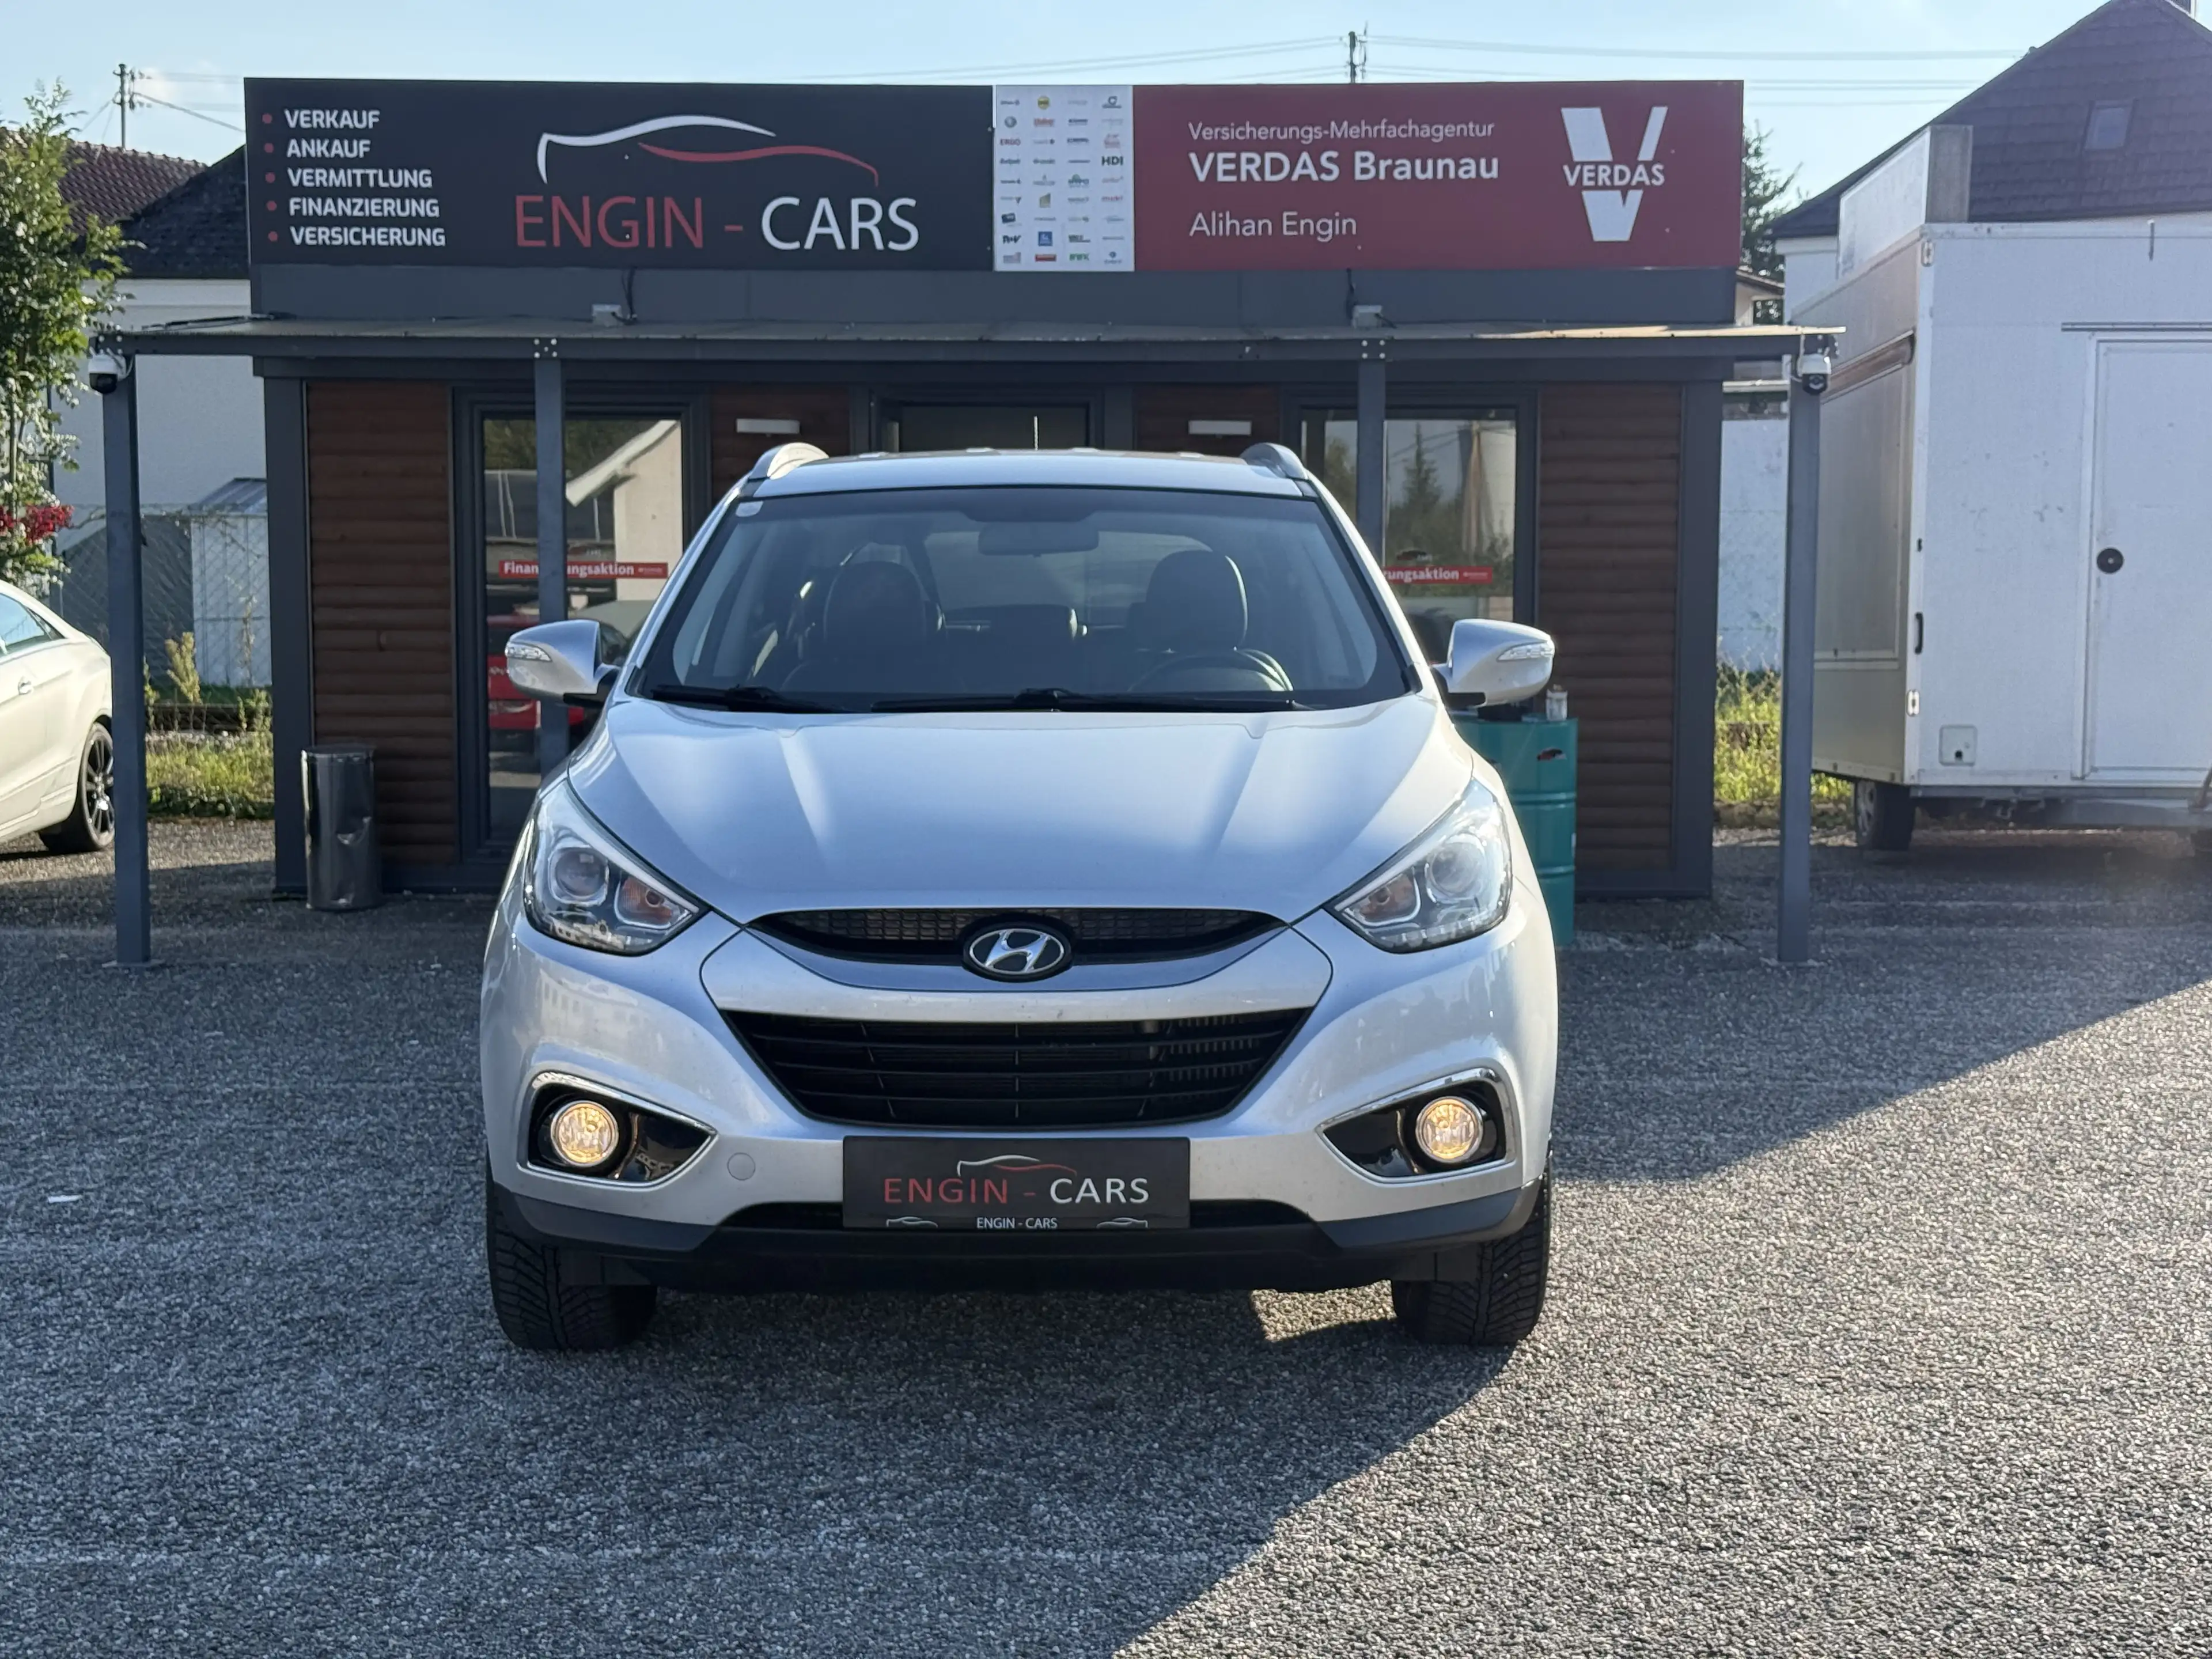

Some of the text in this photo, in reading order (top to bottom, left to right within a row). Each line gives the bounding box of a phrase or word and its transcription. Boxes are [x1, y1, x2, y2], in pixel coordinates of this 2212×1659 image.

[285, 109, 380, 128] VERKAUF
[1188, 118, 1495, 144] Versicherungs-Mehrfachagentur
[287, 139, 370, 158] ANKAUF
[1101, 156, 1124, 166] HDI
[1189, 150, 1498, 182] VERDAS Braunau
[287, 168, 432, 188] VERMITTLUNG
[1563, 164, 1665, 186] VERDAS
[290, 198, 440, 217] FINANZIERUNG
[516, 195, 703, 248] ENGIN
[762, 197, 919, 251] CARS
[1189, 211, 1357, 242] Alihan Engin
[290, 226, 446, 246] VERSICHERUNG
[885, 1179, 1007, 1204] ENGIN
[1050, 1178, 1149, 1203] CARS
[977, 1217, 1015, 1229] ENGIN
[1025, 1217, 1058, 1229] CARS
